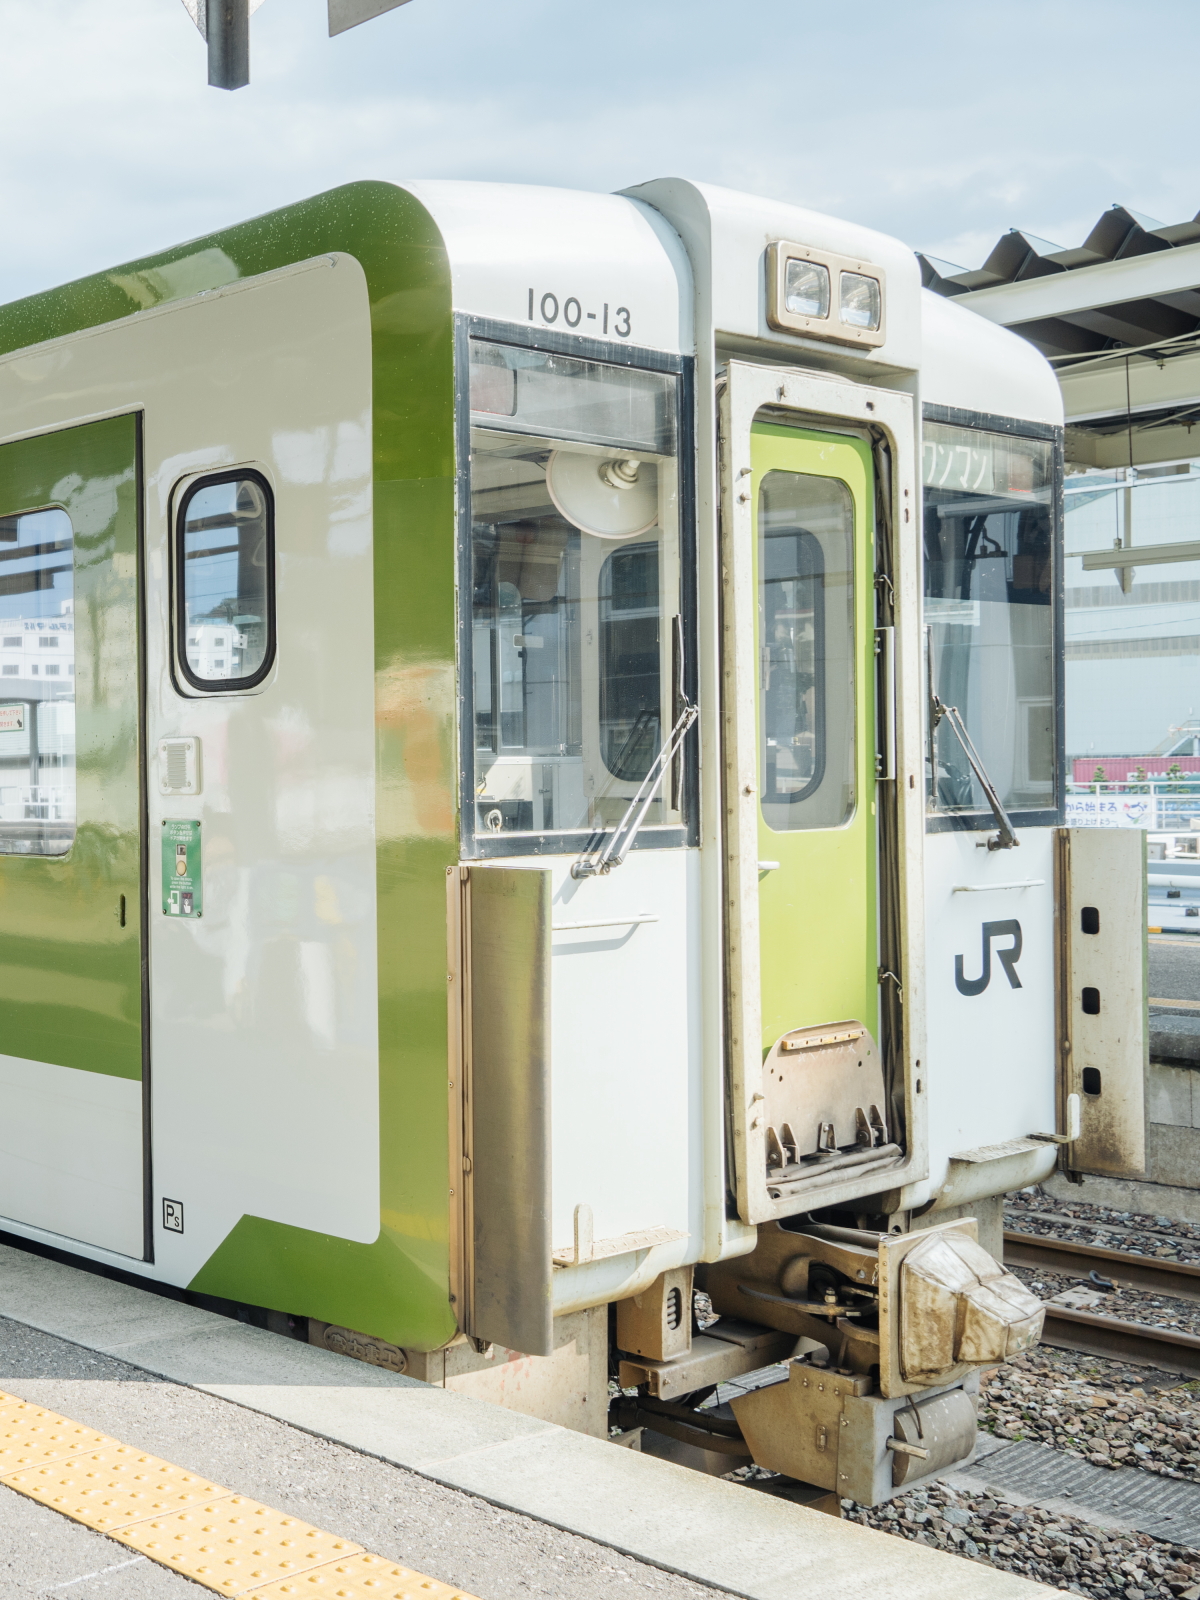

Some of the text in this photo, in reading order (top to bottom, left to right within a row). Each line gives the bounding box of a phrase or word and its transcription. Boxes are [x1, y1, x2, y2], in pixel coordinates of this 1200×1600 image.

[528, 288, 632, 338] 100-13
[921, 441, 987, 489] ワンマン
[955, 919, 1023, 996] JR
